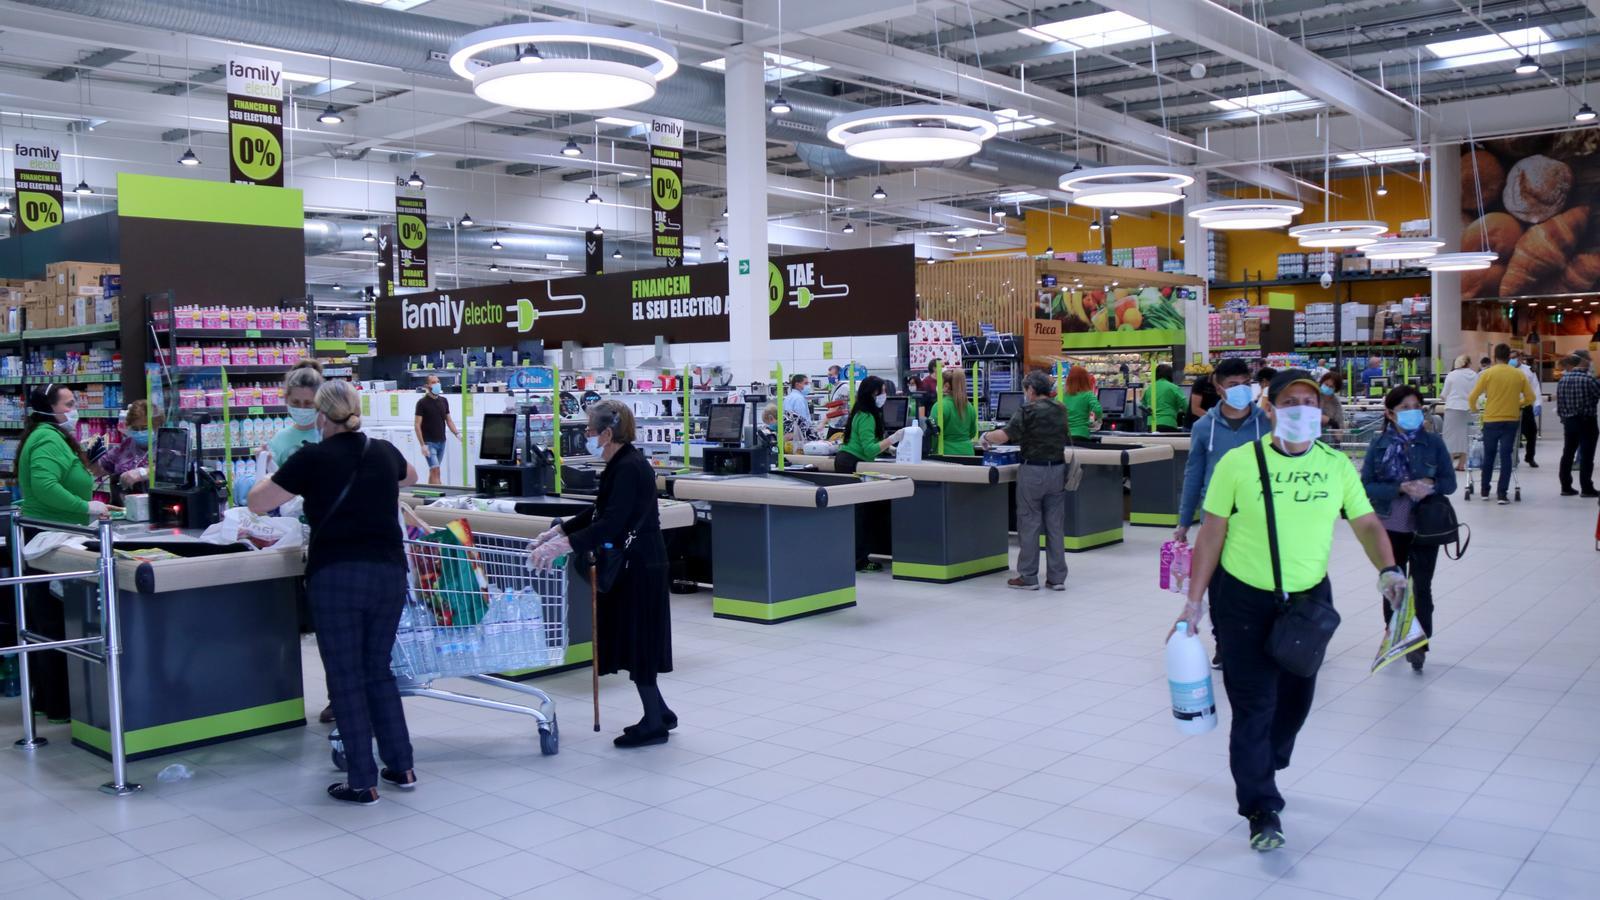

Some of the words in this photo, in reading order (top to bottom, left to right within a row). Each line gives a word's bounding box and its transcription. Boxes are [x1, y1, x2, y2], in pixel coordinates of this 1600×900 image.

[230, 60, 280, 86] family
[245, 81, 280, 98] electro
[234, 99, 268, 113] FINANCEM
[269, 105, 277, 114] EL
[229, 110, 243, 120] SEU
[244, 112, 273, 124] ELECTRO
[273, 116, 282, 125] AL
[652, 120, 682, 138] family
[15, 143, 60, 162] family
[240, 136, 275, 167] 0%
[16, 181, 28, 189] SEU
[29, 182, 54, 191] ELECTRO
[657, 177, 678, 200] 0%
[25, 201, 57, 223] 0%
[654, 210, 667, 222] TAE
[402, 222, 423, 240] 0%
[786, 262, 815, 287] TAE
[632, 275, 691, 299] FINANCEM
[402, 294, 465, 334] family
[464, 300, 503, 325] electro
[632, 301, 645, 321] EL
[646, 299, 668, 320] SEU
[670, 295, 722, 318] ELECTRO
[1294, 490, 1329, 502] UP
